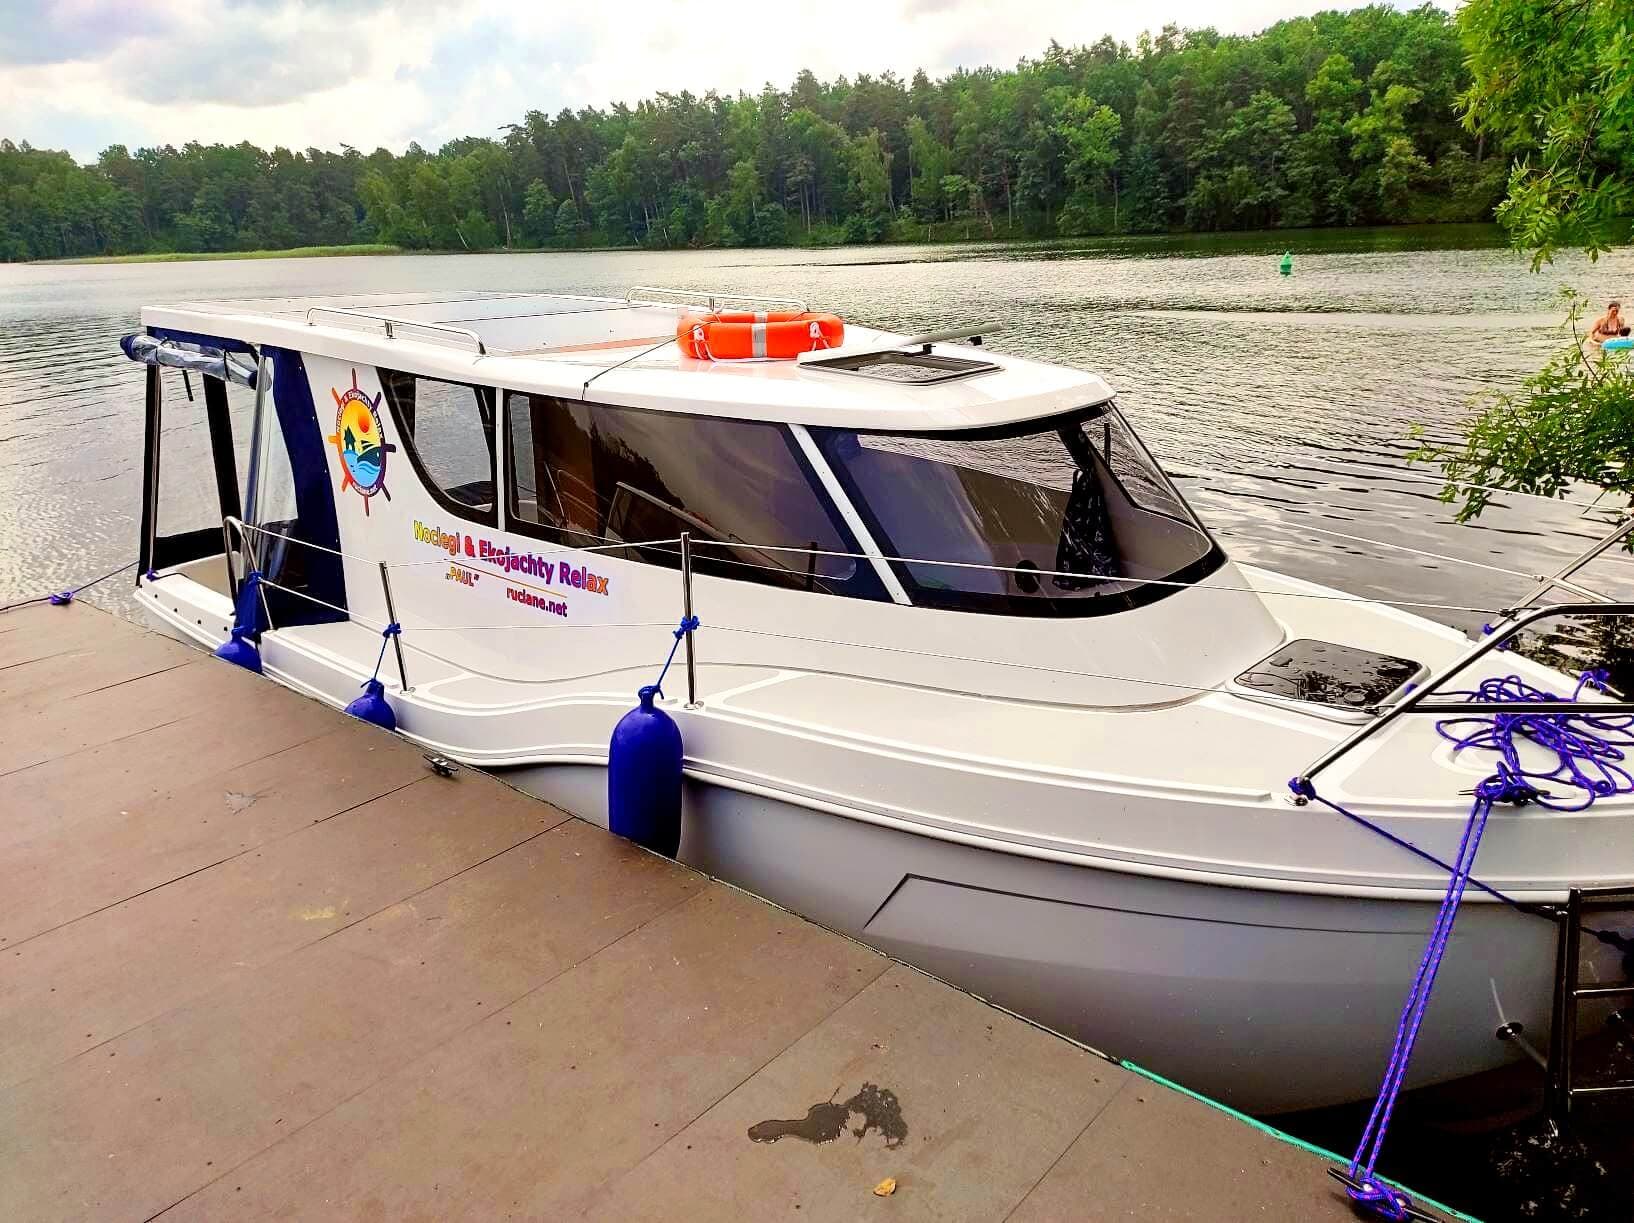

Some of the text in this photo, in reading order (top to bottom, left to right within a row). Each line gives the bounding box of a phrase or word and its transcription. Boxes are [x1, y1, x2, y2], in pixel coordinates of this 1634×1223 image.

[413, 520, 609, 596] Noclegi & Ekojachty Relax
